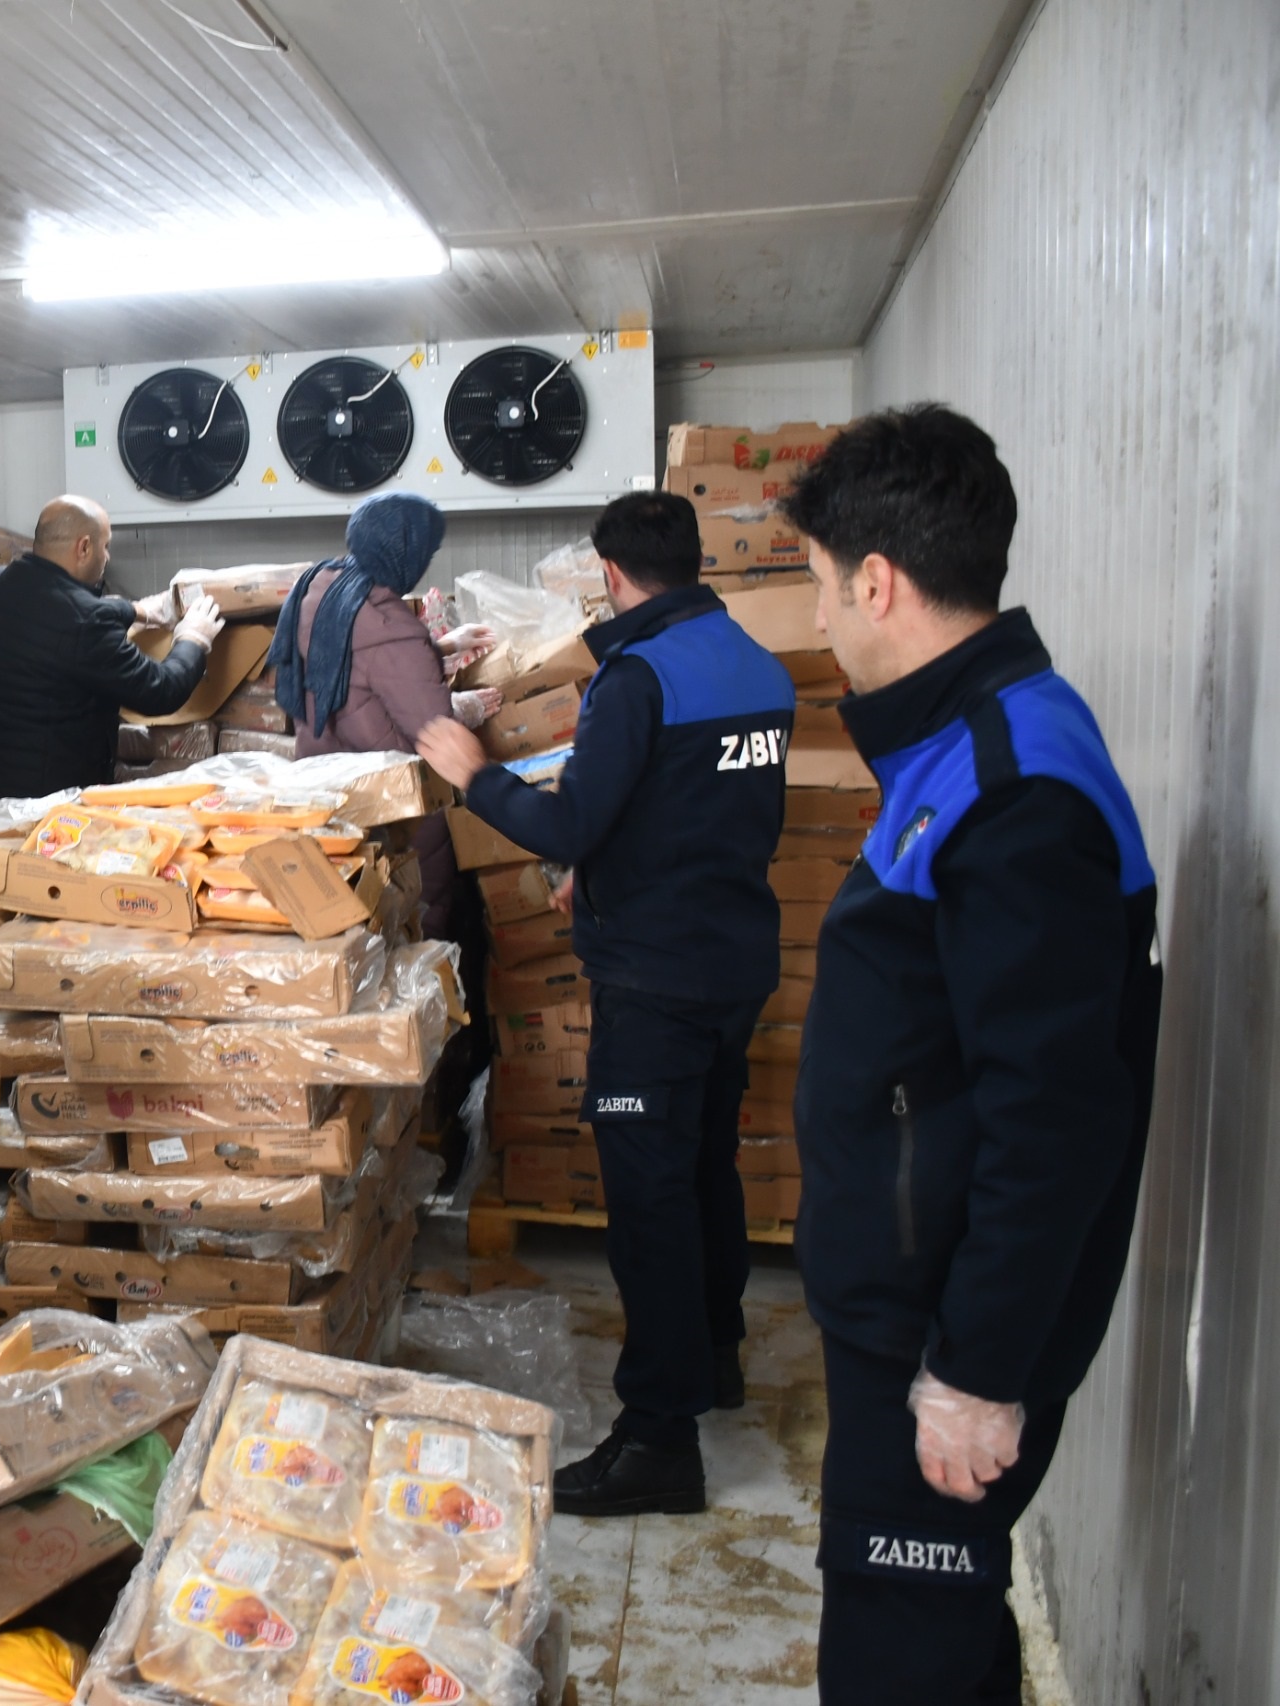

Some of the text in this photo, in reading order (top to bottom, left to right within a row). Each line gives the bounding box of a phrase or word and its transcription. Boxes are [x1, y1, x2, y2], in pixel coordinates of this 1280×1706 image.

[790, 552, 809, 564] pili
[717, 728, 787, 772] ZABI
[597, 1097, 644, 1112] ZABITA
[868, 1536, 974, 1573] ZABITA
